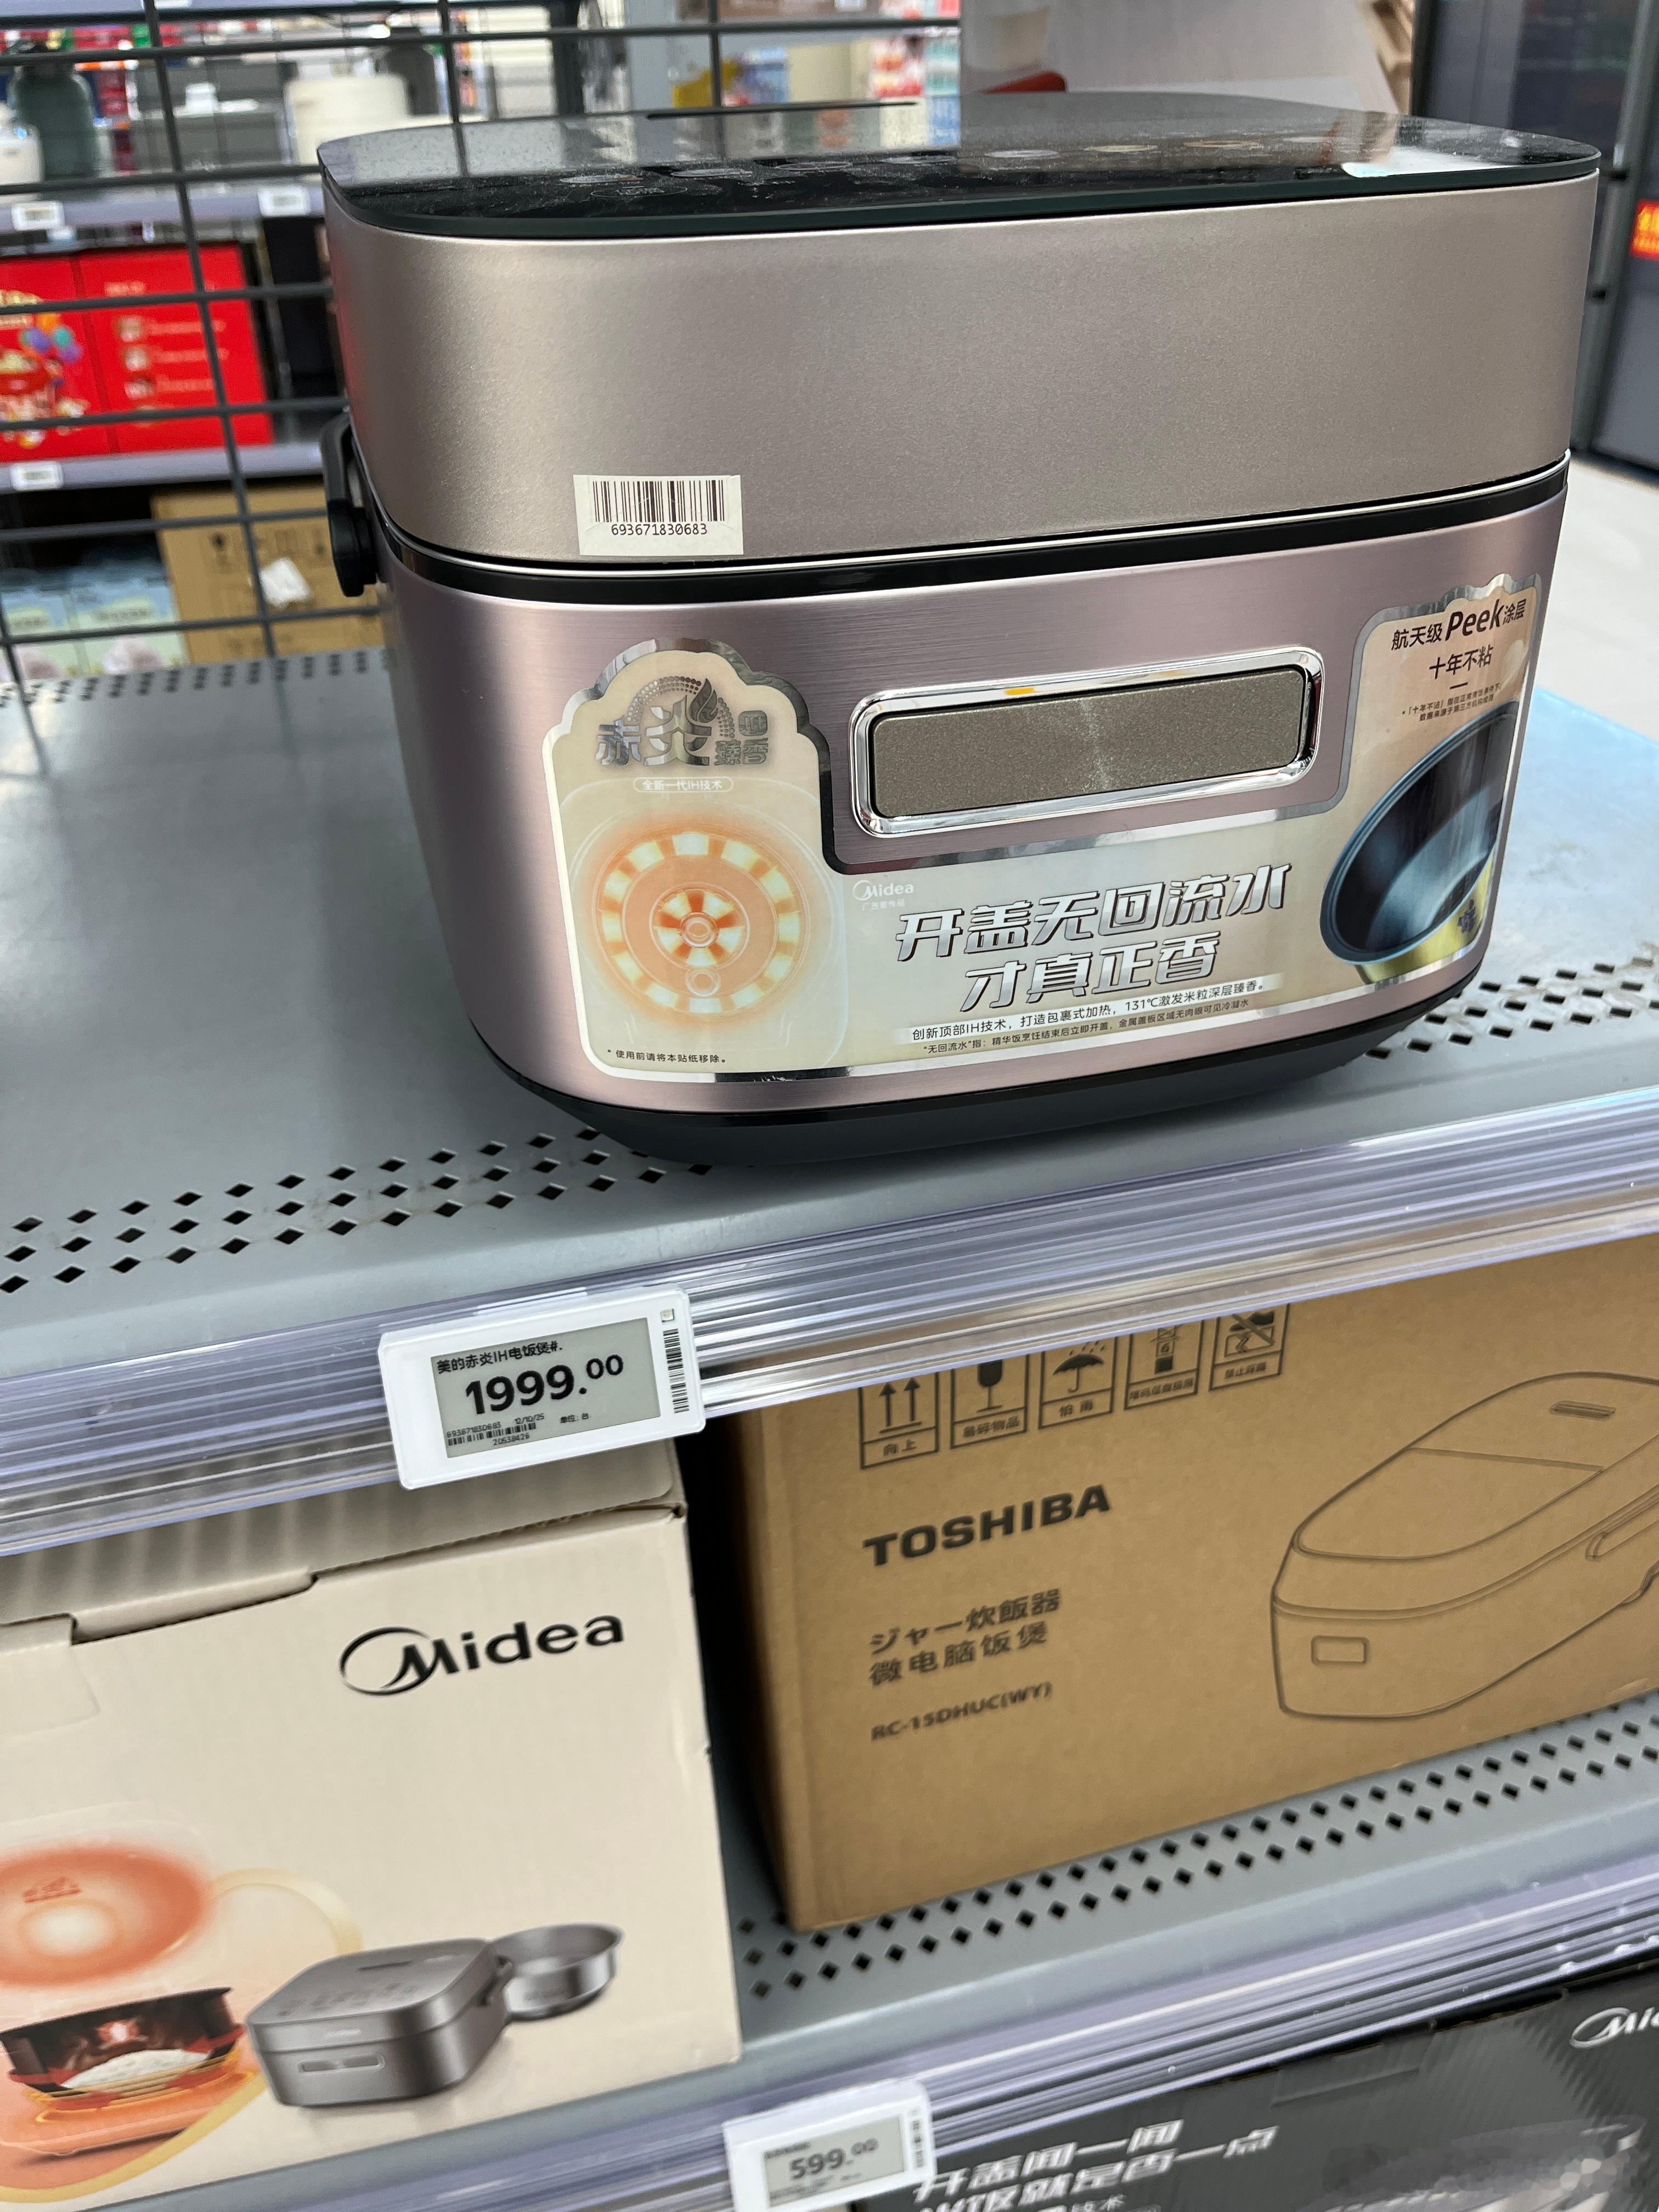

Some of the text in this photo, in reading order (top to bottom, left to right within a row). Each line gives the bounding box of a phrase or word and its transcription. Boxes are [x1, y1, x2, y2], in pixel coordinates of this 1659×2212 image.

[611, 523, 708, 536] 693671830683
[1429, 644, 1494, 680] 十年不粘
[642, 779, 723, 791] 全新一代IH技术
[853, 879, 914, 901] Midea
[895, 863, 1292, 962] 开盖无回流水
[960, 930, 1221, 1013] 才真正香
[616, 1049, 726, 1063] 使用前请将本贴纸移除。
[437, 1340, 563, 1374] 美的赤炎IH电饭煲#.
[465, 1353, 624, 1415] 1999.00
[862, 1483, 1111, 1567] TOSHIBA
[869, 1588, 1062, 1655] ジャー炊飯器
[338, 1615, 625, 1696] Midea
[868, 1620, 1048, 1686] 微电脑饭煲
[871, 1680, 1053, 1741] RC-15DHUC(WY)
